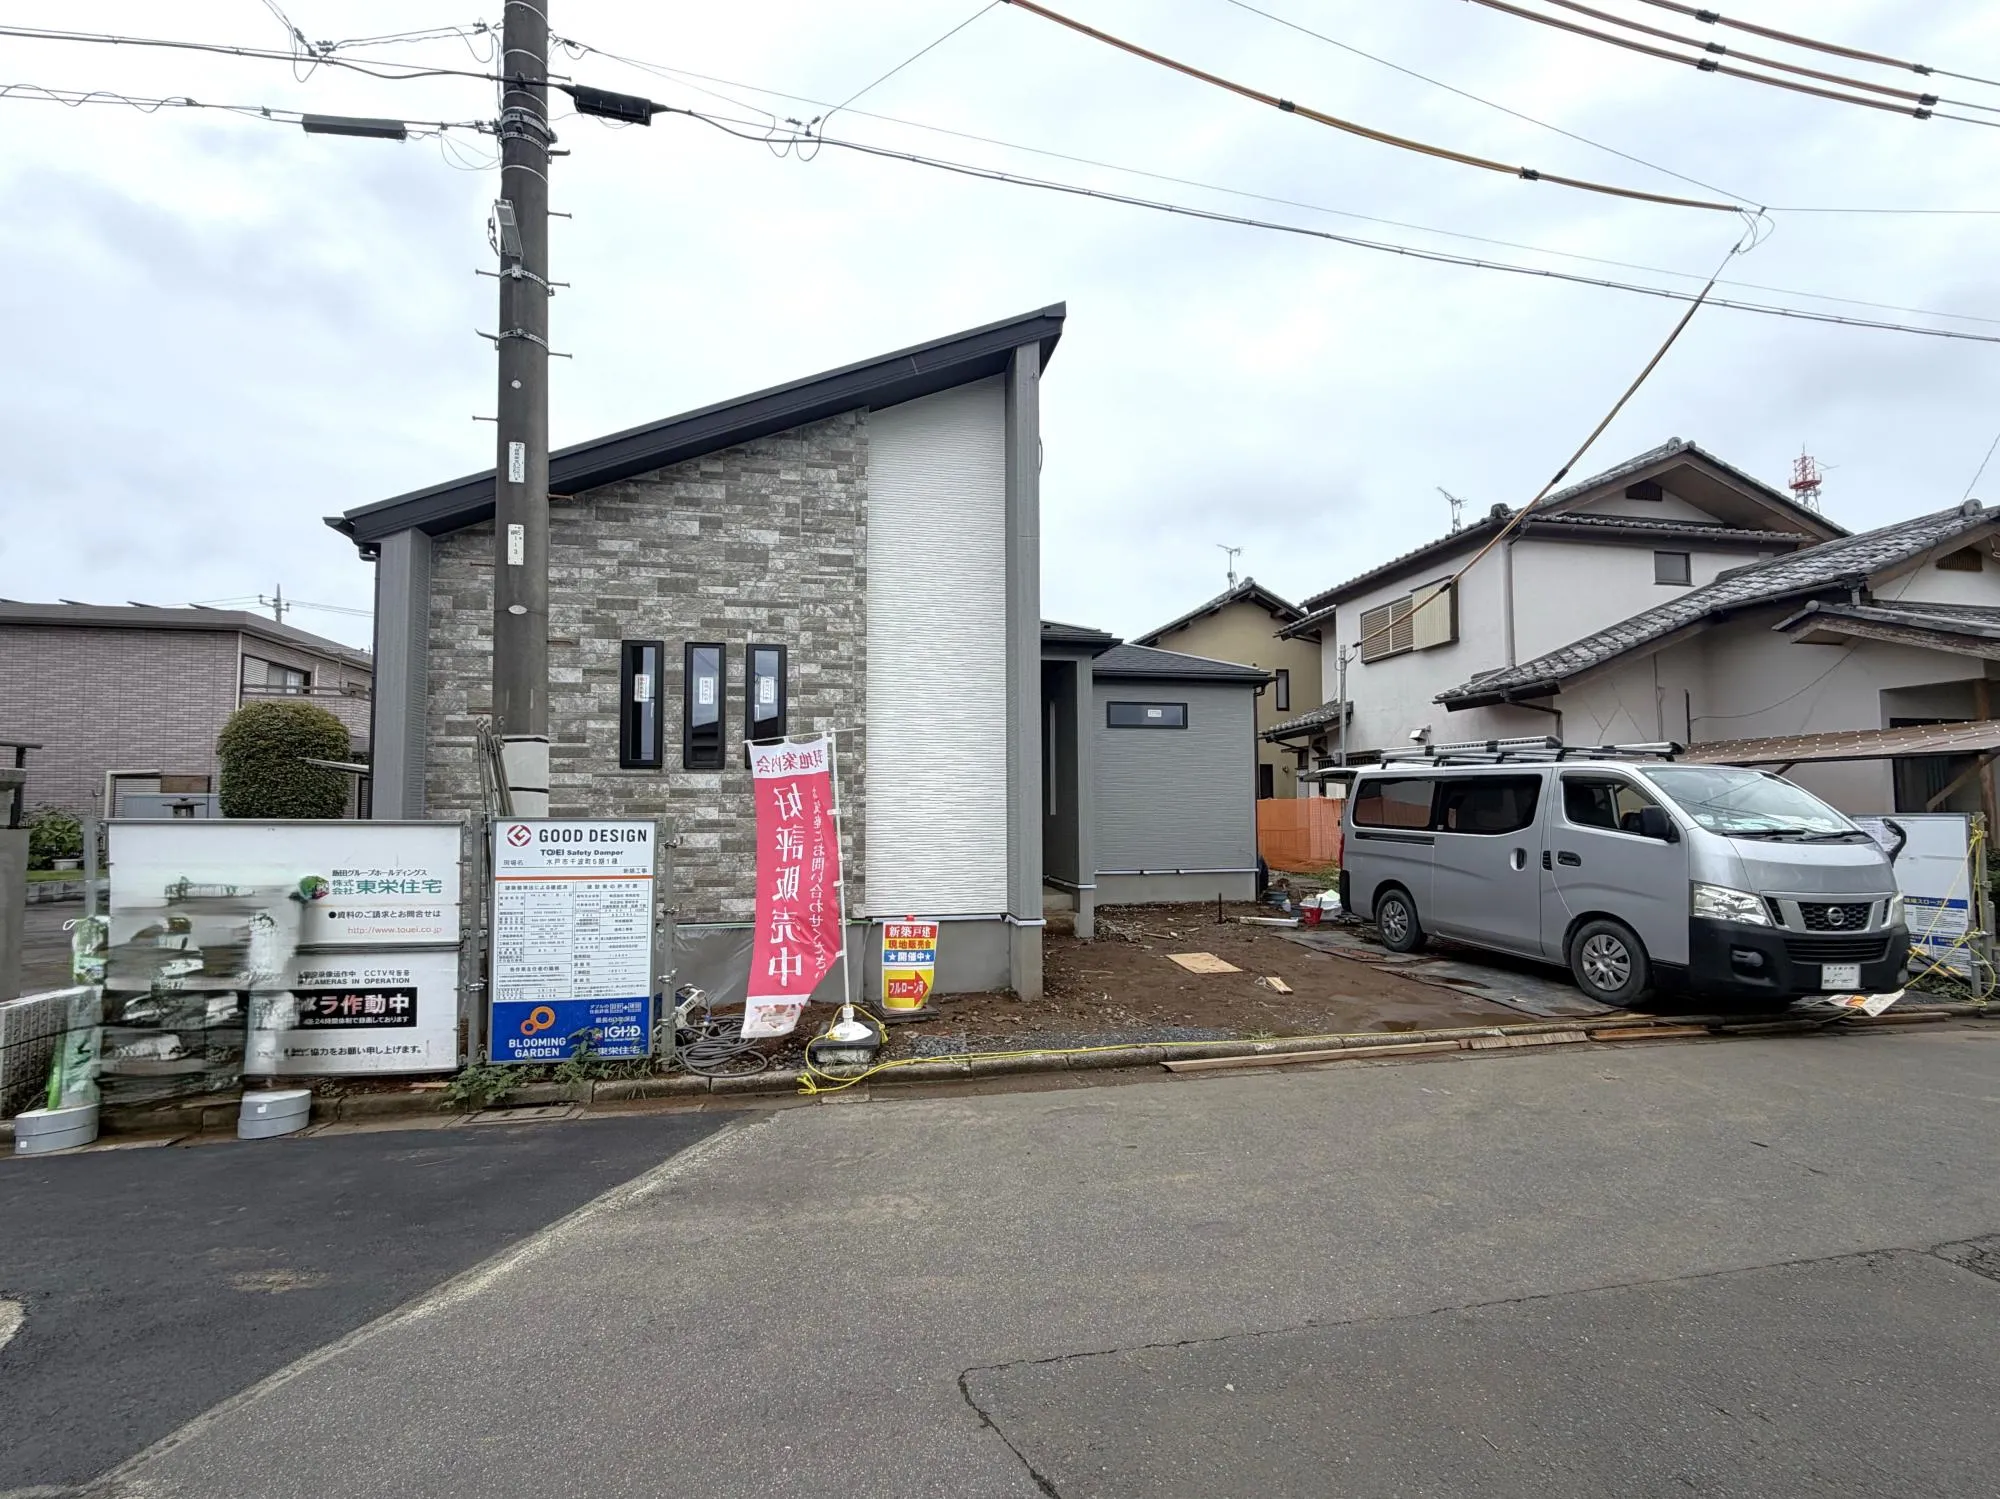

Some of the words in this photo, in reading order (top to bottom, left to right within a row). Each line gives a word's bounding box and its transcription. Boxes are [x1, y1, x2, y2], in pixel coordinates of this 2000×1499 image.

[539, 829, 583, 843] GOOD
[589, 829, 647, 843] DESIGN
[567, 849, 592, 857] Safety
[594, 849, 624, 857] Damper
[332, 869, 428, 877] 飯田グループホールディングス
[356, 879, 443, 895] 東栄住宅
[348, 926, 442, 935] http://www.touei.co.jp
[889, 926, 931, 937] 新築戸建
[508, 1037, 566, 1048] BLOOMING
[514, 1047, 560, 1058] GARDEN
